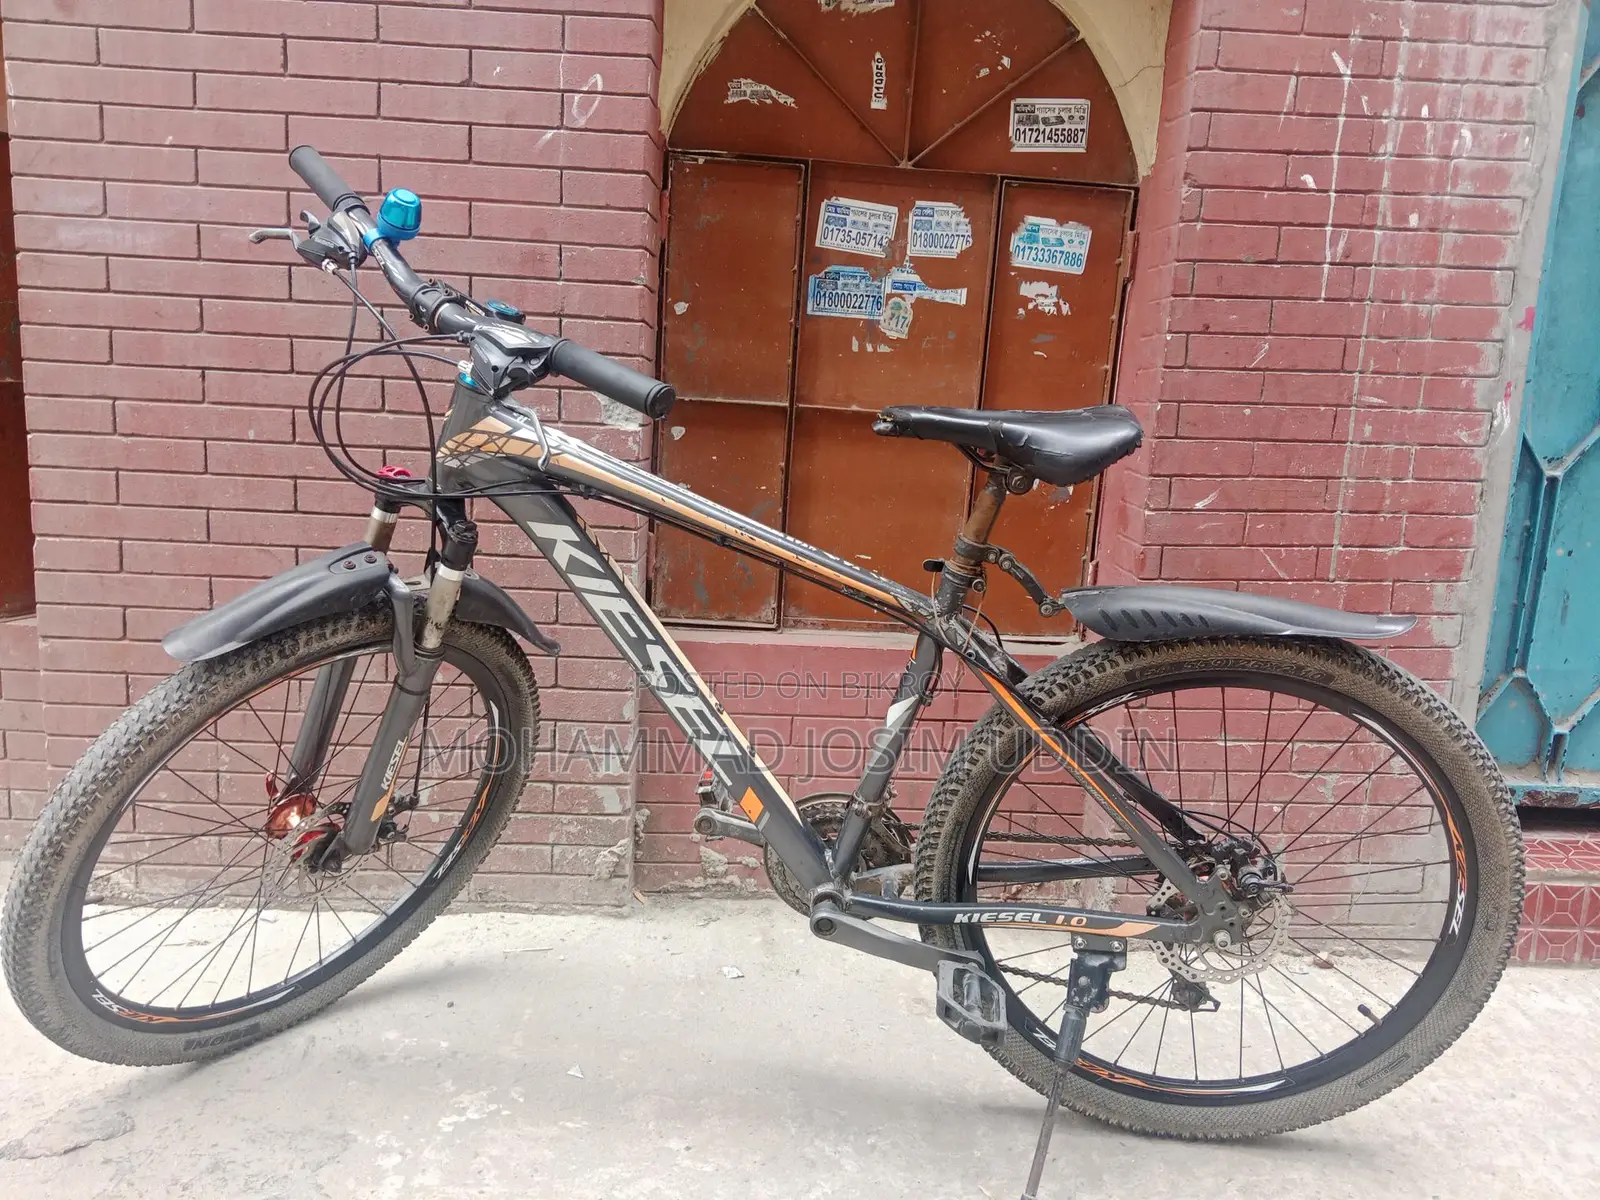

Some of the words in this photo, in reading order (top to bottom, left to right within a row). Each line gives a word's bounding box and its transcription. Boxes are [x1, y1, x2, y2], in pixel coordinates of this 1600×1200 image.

[1014, 127, 1086, 144] 01721455887
[912, 231, 971, 250] 01800022776
[1014, 244, 1083, 268] 01733367886
[815, 290, 883, 312] 01800022776
[526, 521, 742, 787] KIESEL
[381, 739, 404, 790] KIESEL
[953, 911, 1047, 924] KIESEL
